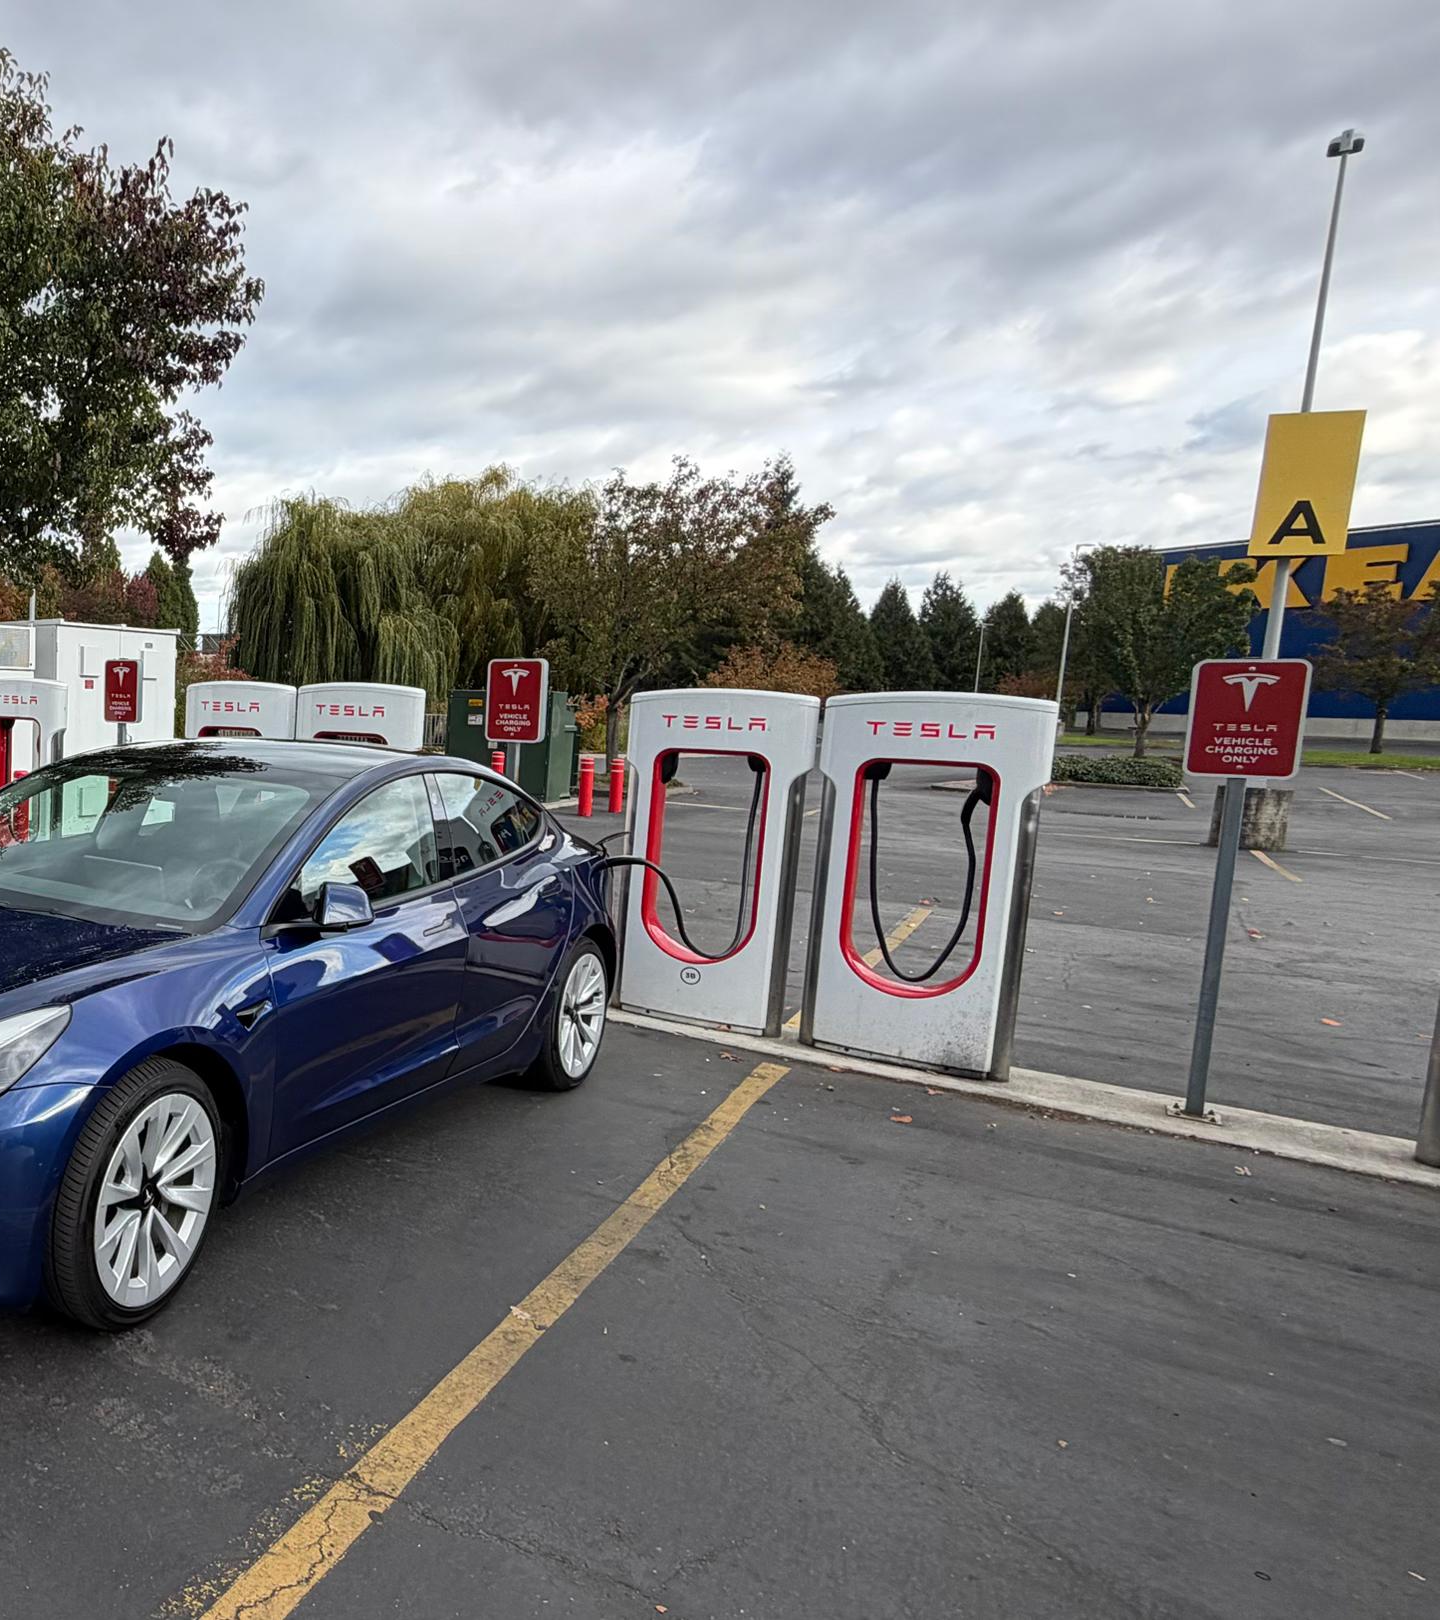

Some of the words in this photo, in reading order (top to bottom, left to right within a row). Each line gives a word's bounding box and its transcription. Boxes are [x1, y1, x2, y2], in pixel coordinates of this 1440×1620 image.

[1267, 500, 1326, 544] A
[1164, 543, 1440, 608] KE
[201, 701, 260, 713] TESLA
[316, 704, 384, 717] TESLA
[662, 714, 768, 732] TESLA
[1213, 723, 1278, 732] TESLA
[866, 721, 996, 740] TESLA
[1214, 737, 1272, 746] VEHICLE
[1205, 746, 1278, 756] CHARGING
[1221, 755, 1259, 764] ONLY
